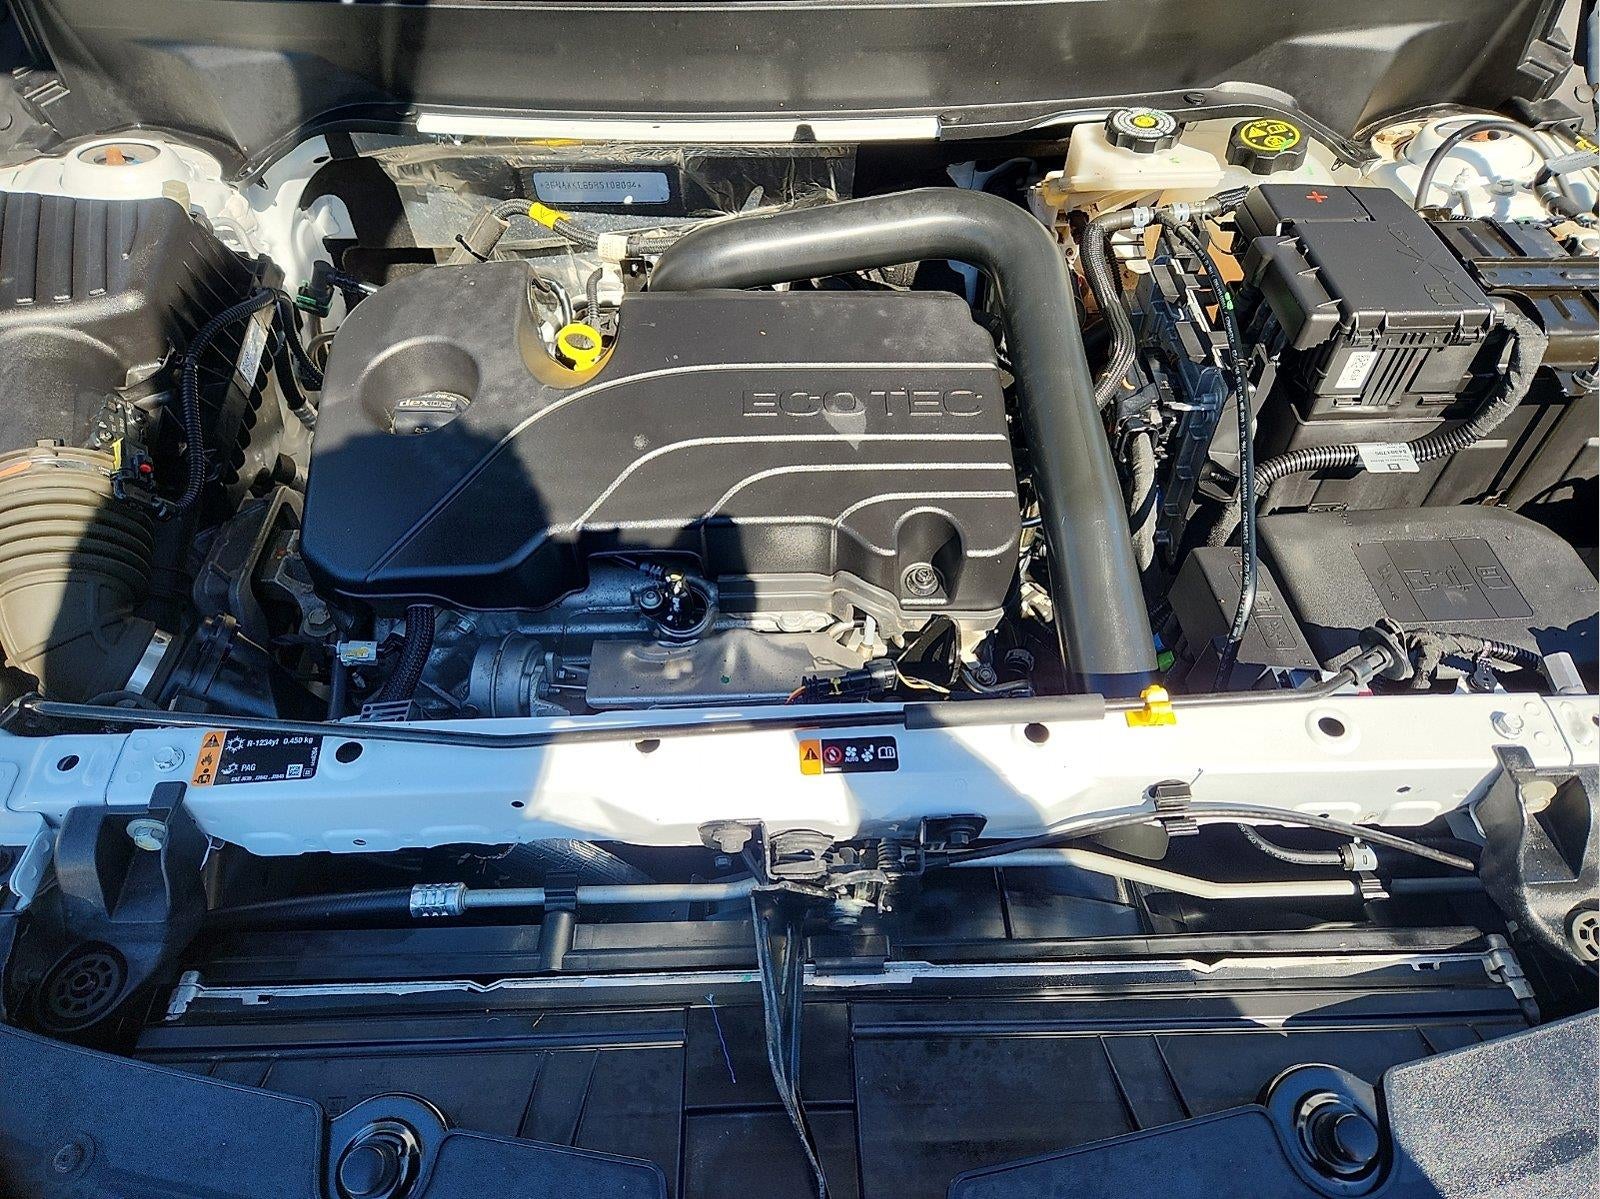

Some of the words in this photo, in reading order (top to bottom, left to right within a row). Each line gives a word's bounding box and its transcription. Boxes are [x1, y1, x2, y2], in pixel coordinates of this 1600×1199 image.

[399, 399, 452, 408] dexos
[742, 390, 984, 416] ECOTEC
[303, 736, 314, 744] kg
[241, 763, 256, 772] PAG
